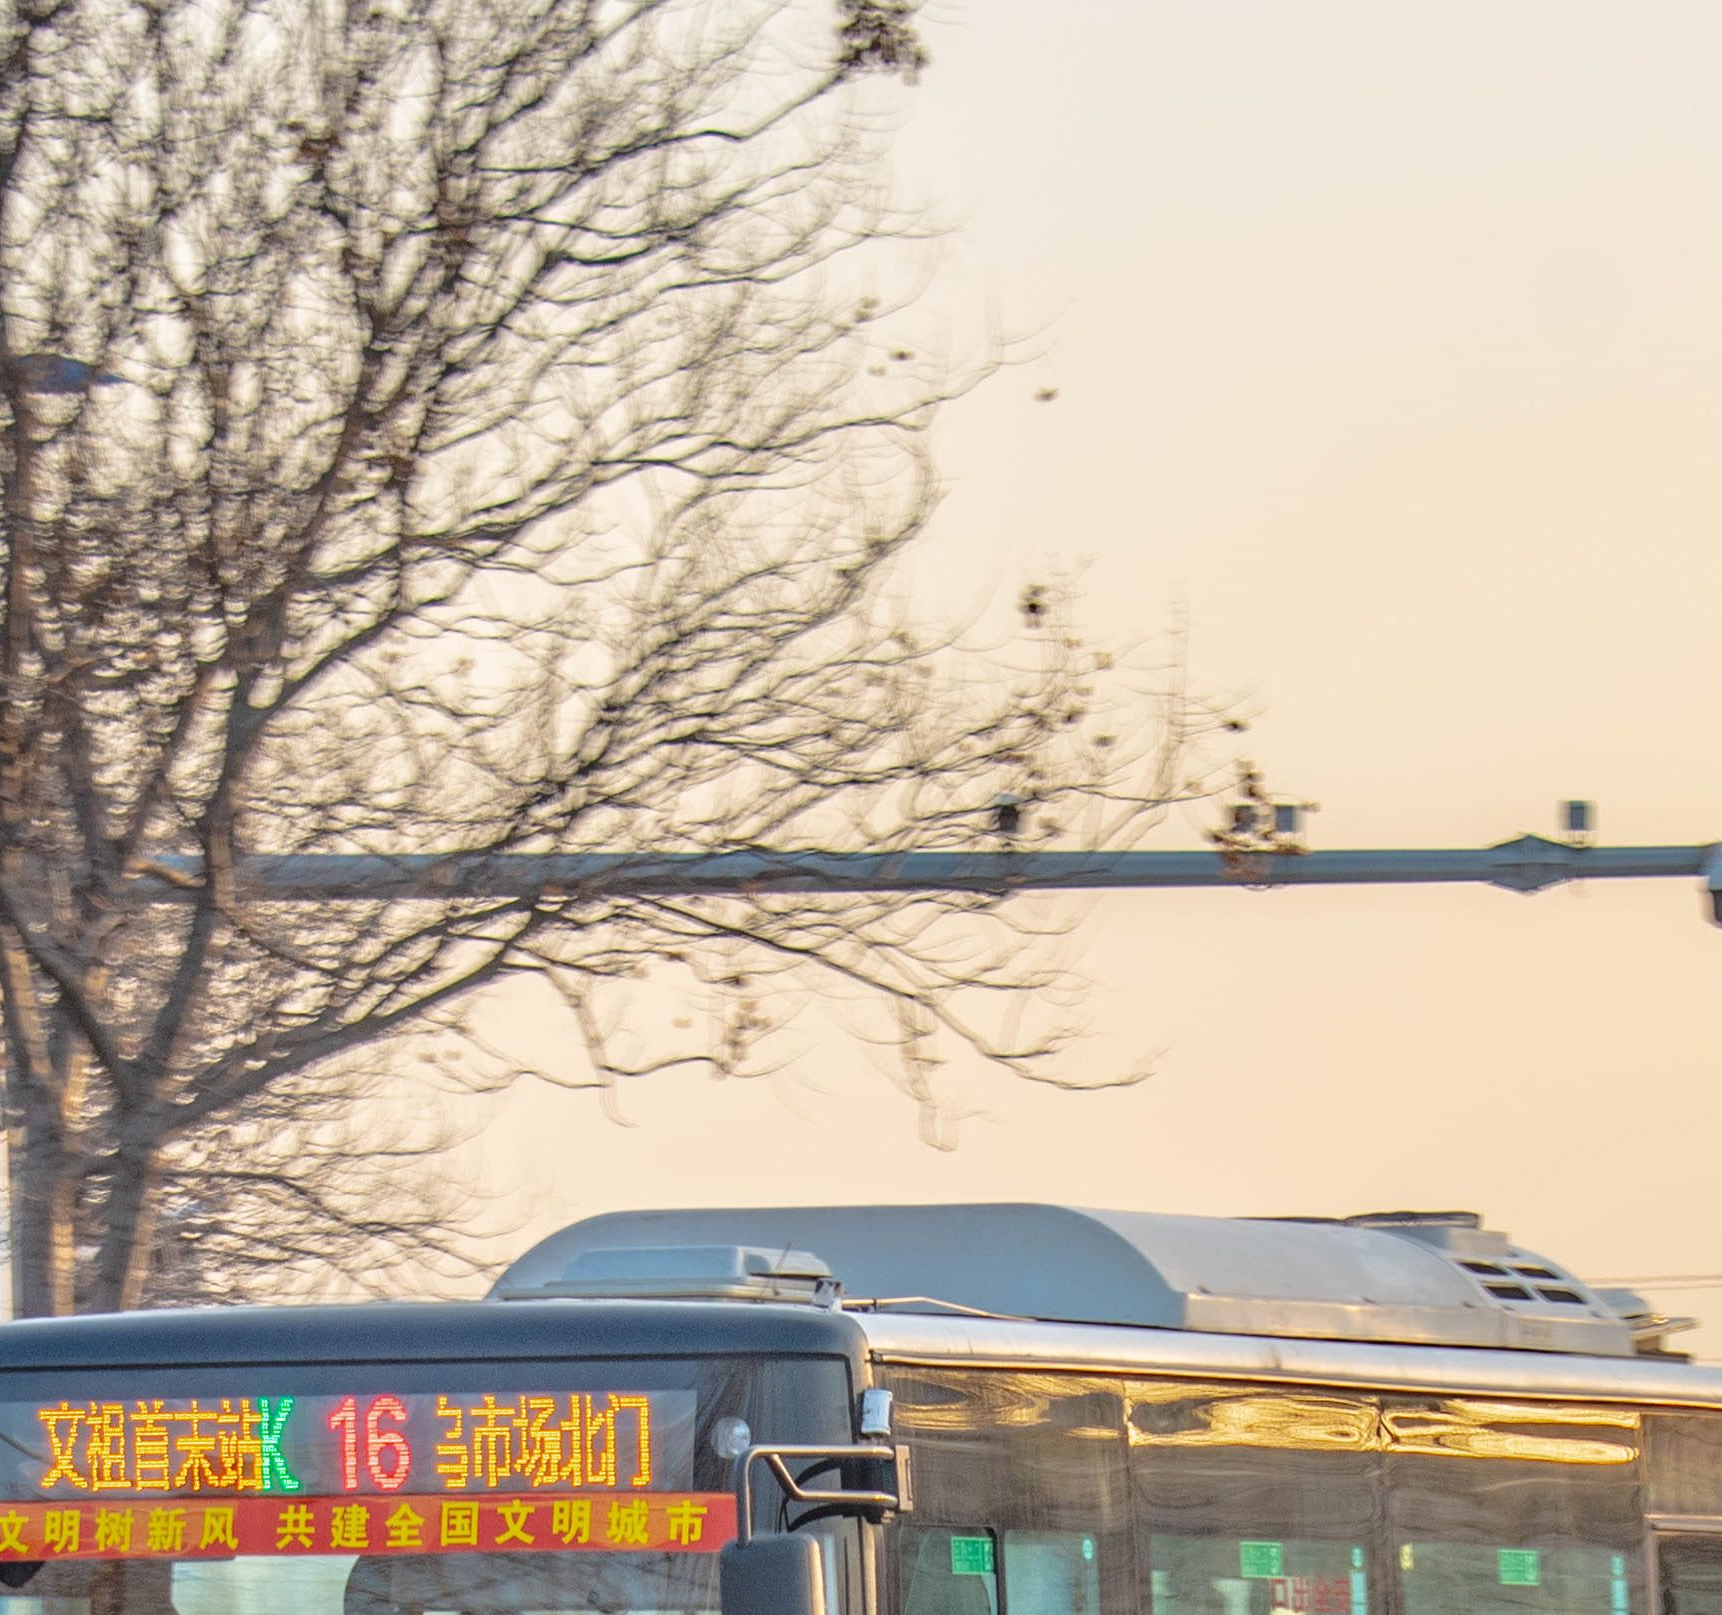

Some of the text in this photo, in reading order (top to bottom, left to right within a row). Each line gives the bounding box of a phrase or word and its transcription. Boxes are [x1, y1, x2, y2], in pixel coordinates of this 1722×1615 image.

[256, 1396, 300, 1489] K
[329, 1396, 411, 1489] 16
[276, 1500, 707, 1551] 共建全国文明城市
